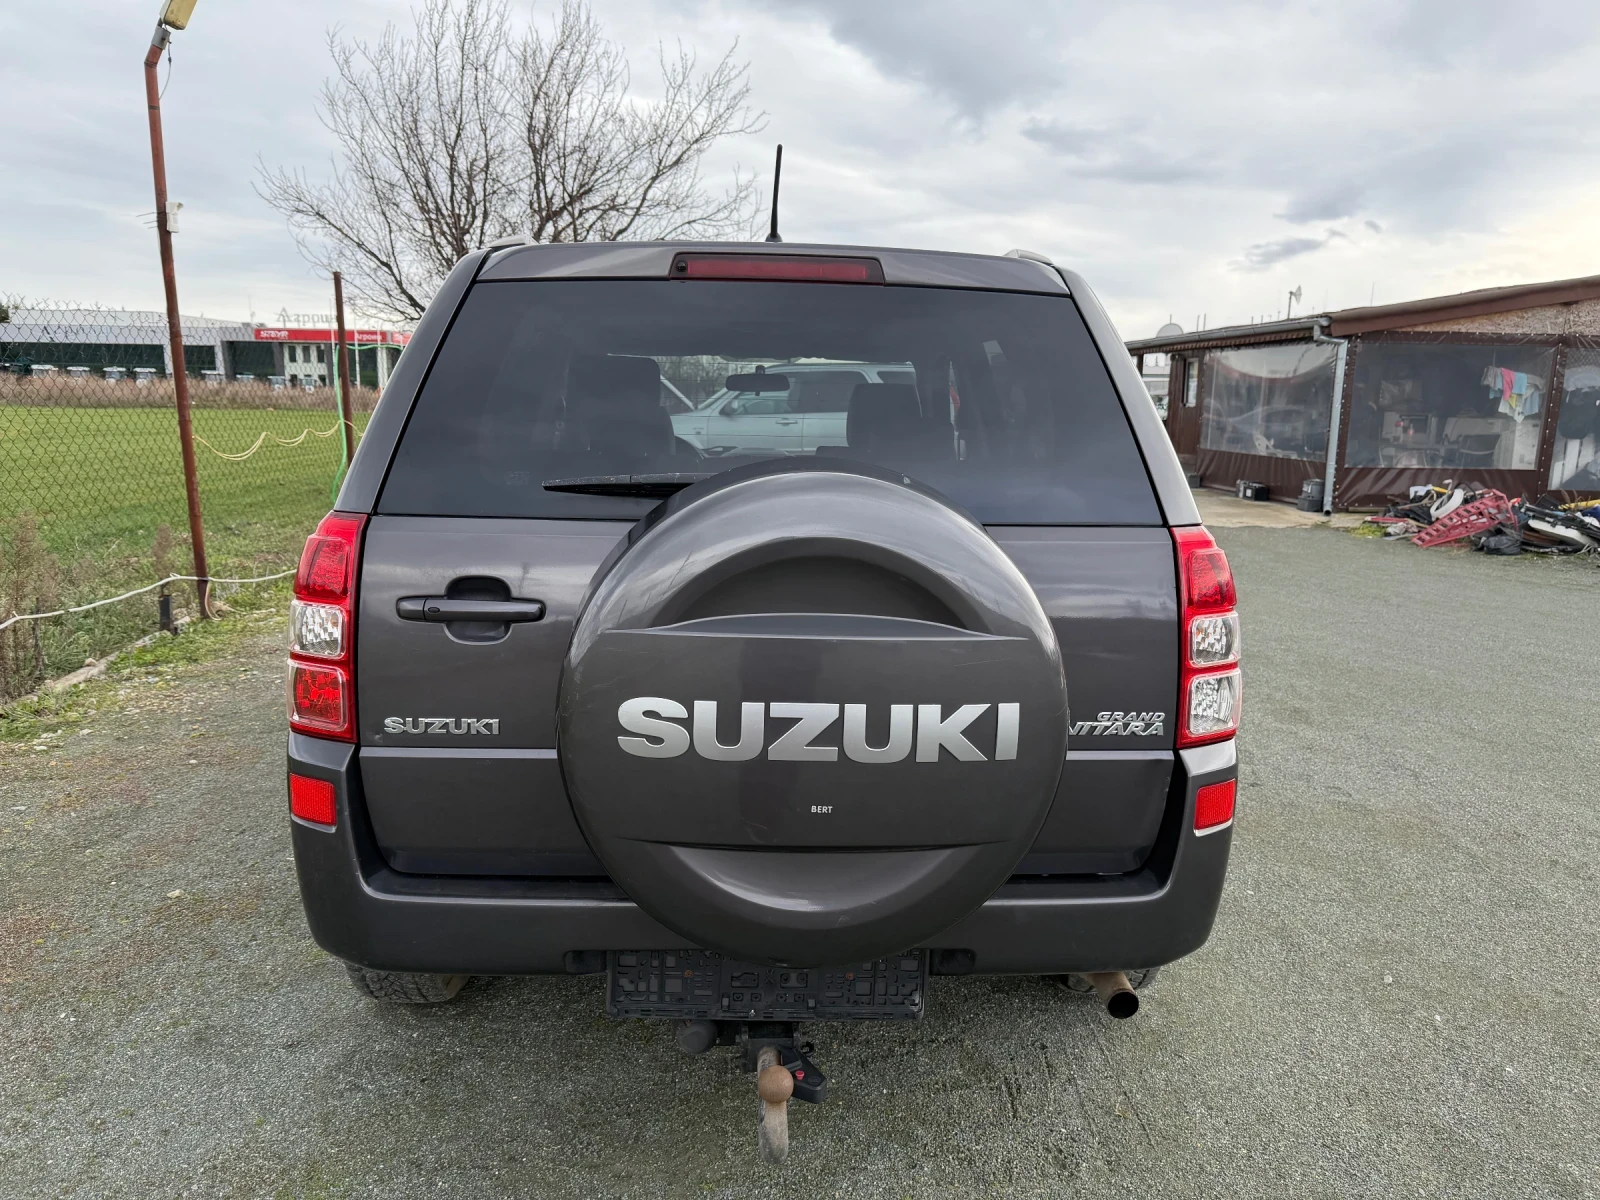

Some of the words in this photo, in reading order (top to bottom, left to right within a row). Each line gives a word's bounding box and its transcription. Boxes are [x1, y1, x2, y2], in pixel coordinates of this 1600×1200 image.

[1097, 712, 1165, 722] GRAND
[383, 716, 500, 735] SUZUKI
[617, 696, 1021, 763] SUZUKI
[811, 805, 833, 814] BERT
